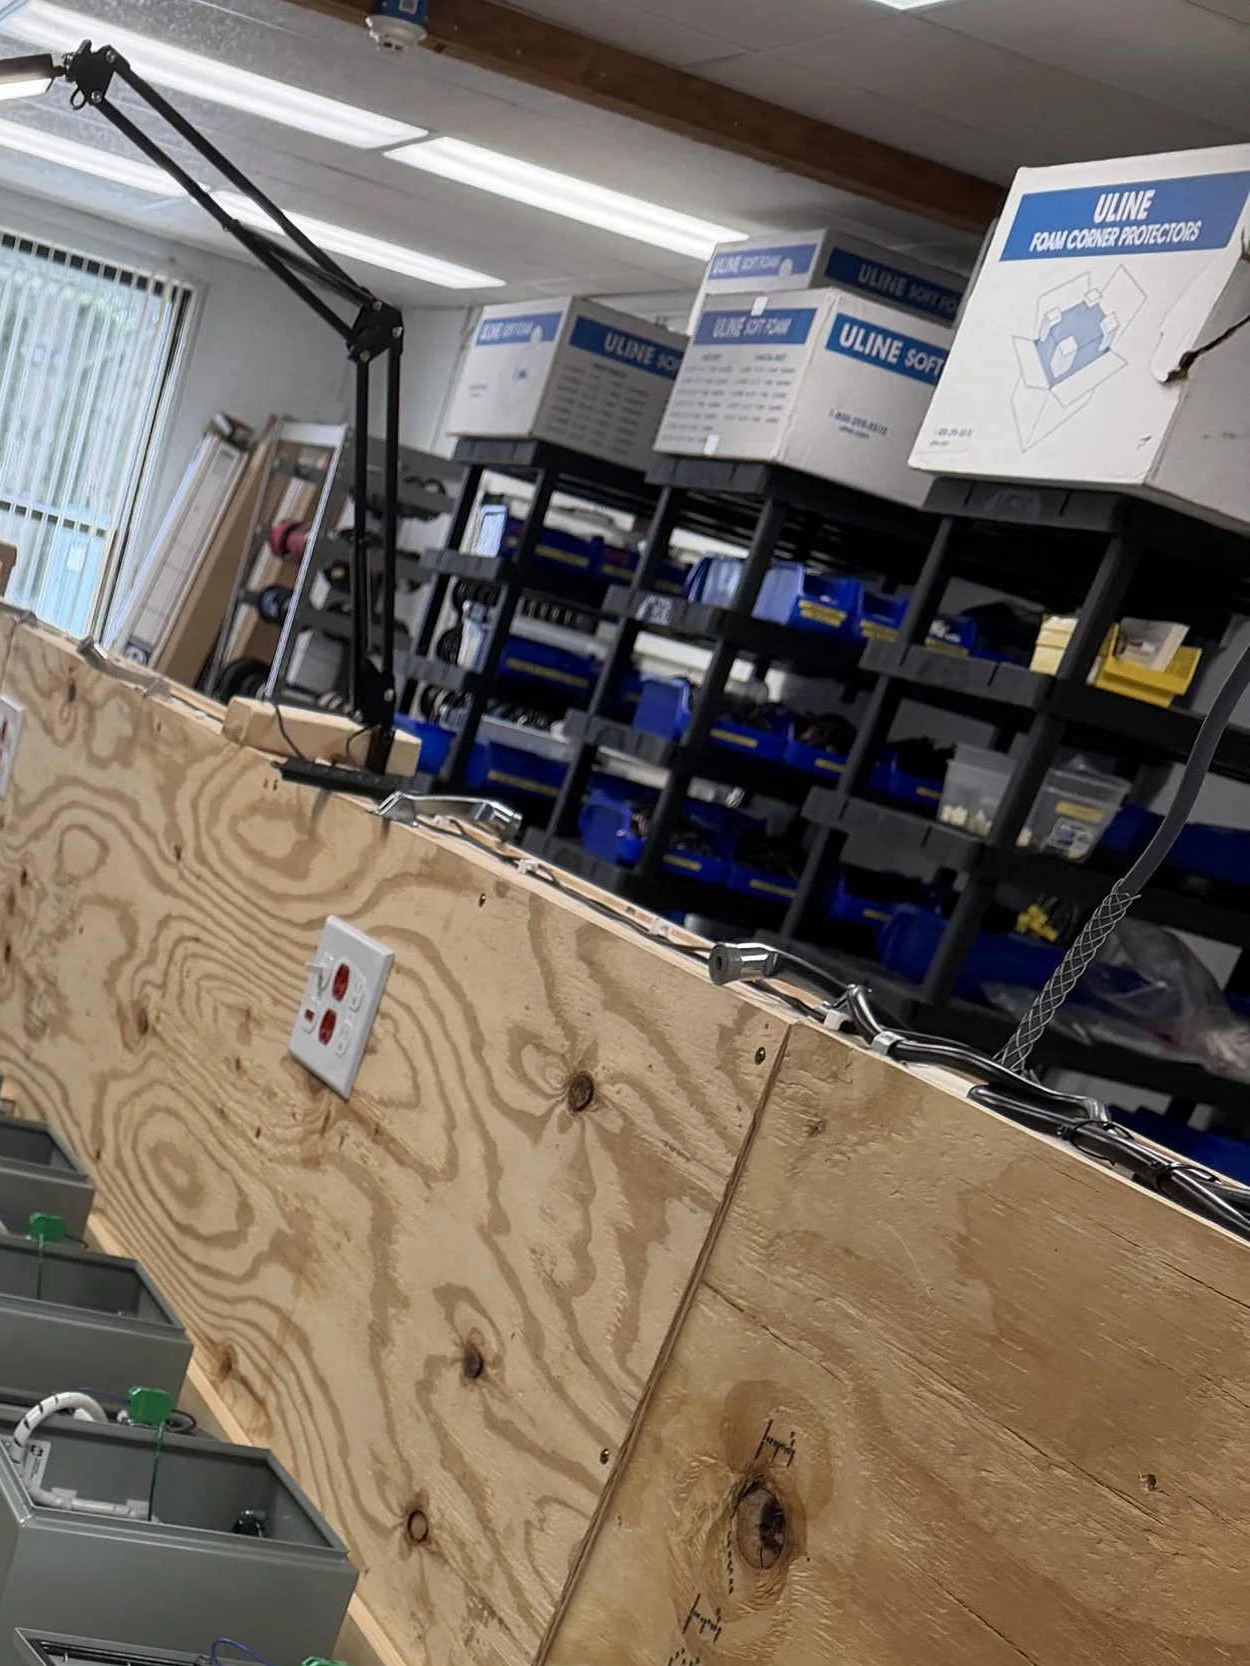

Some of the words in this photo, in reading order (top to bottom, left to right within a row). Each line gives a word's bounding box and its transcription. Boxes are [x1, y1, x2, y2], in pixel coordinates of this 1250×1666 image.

[1093, 189, 1156, 224] ULINE
[1029, 230, 1068, 252] FOAM
[1067, 226, 1120, 249] CORNER
[1118, 220, 1202, 246] PROTECTORS
[858, 263, 908, 296] ULINE
[604, 332, 656, 366] ULINE
[838, 322, 903, 365] ULINE
[903, 348, 944, 376] SOFT
